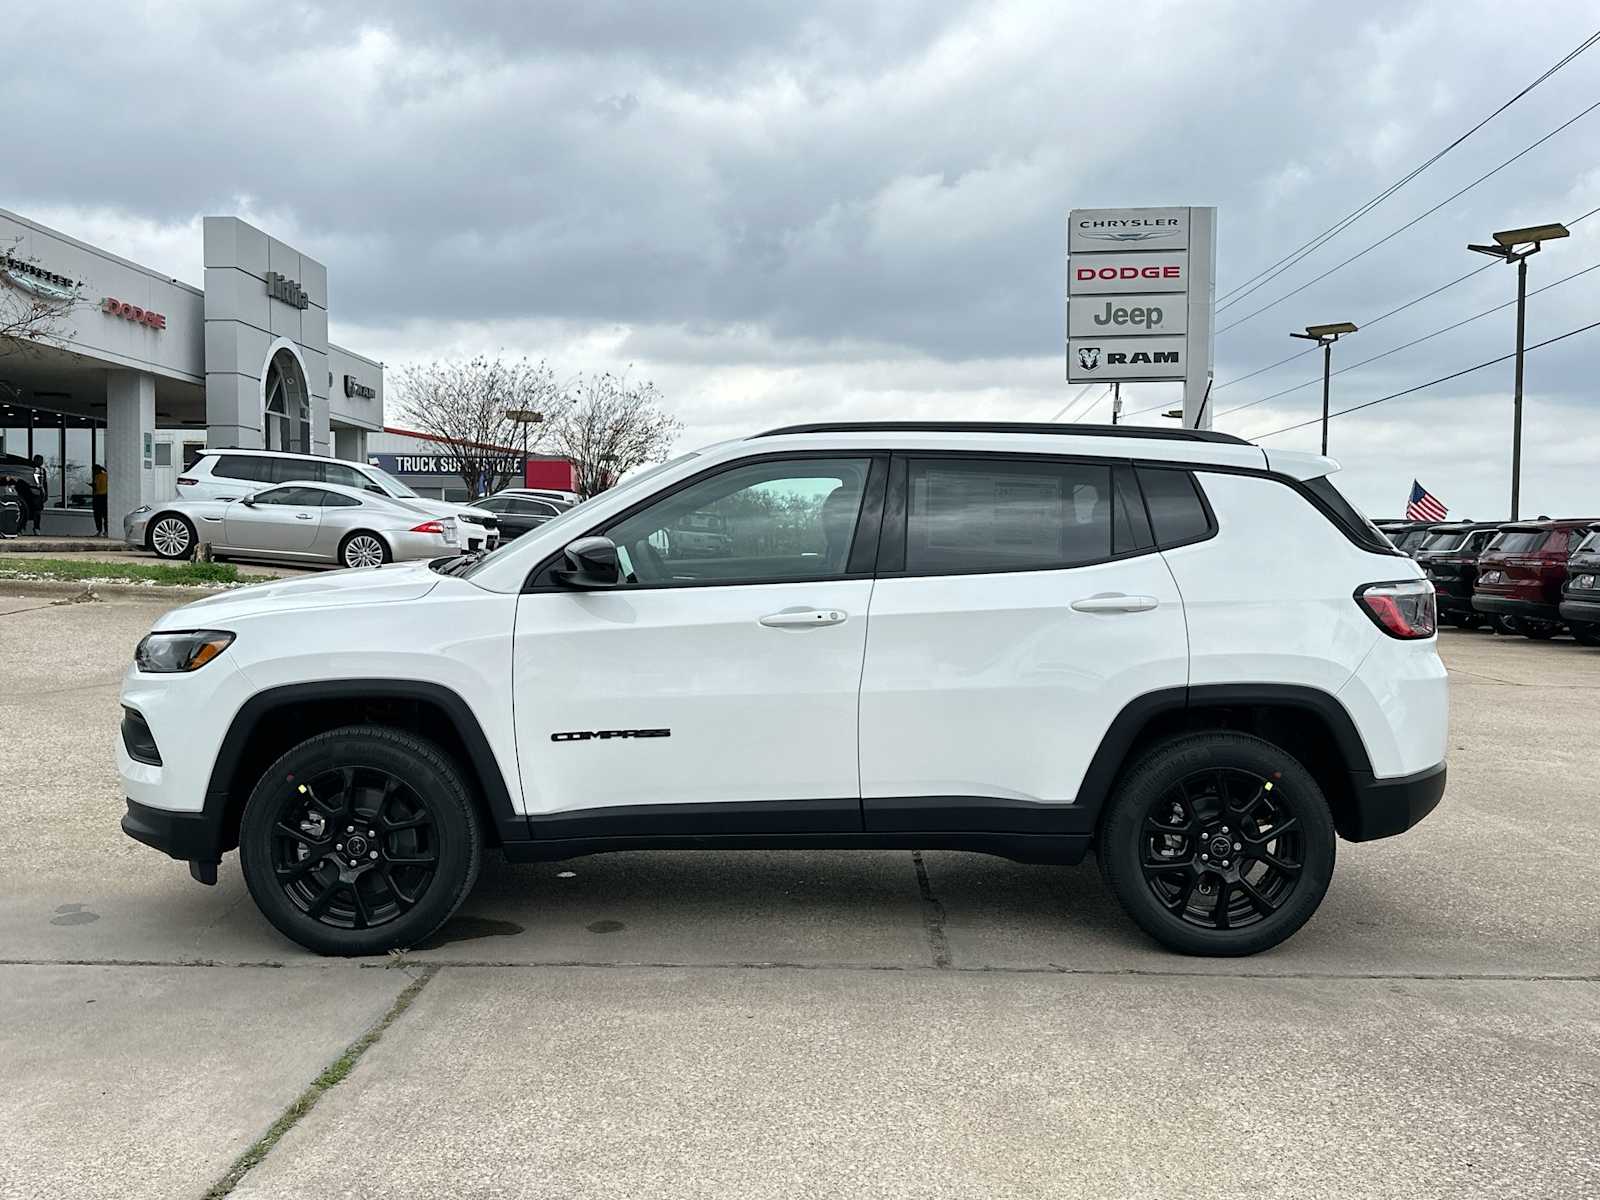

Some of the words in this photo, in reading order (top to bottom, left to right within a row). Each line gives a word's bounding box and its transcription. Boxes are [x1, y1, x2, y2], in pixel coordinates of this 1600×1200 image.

[1080, 218, 1179, 229] CHRYSLER
[1077, 266, 1181, 281] DODGE
[102, 296, 167, 330] DODGE
[1094, 302, 1163, 329] Jeep
[1107, 351, 1179, 365] RAM
[395, 456, 438, 472] TRUCK
[440, 456, 521, 473] SUPRSTORE
[551, 728, 671, 742] COMPASS
